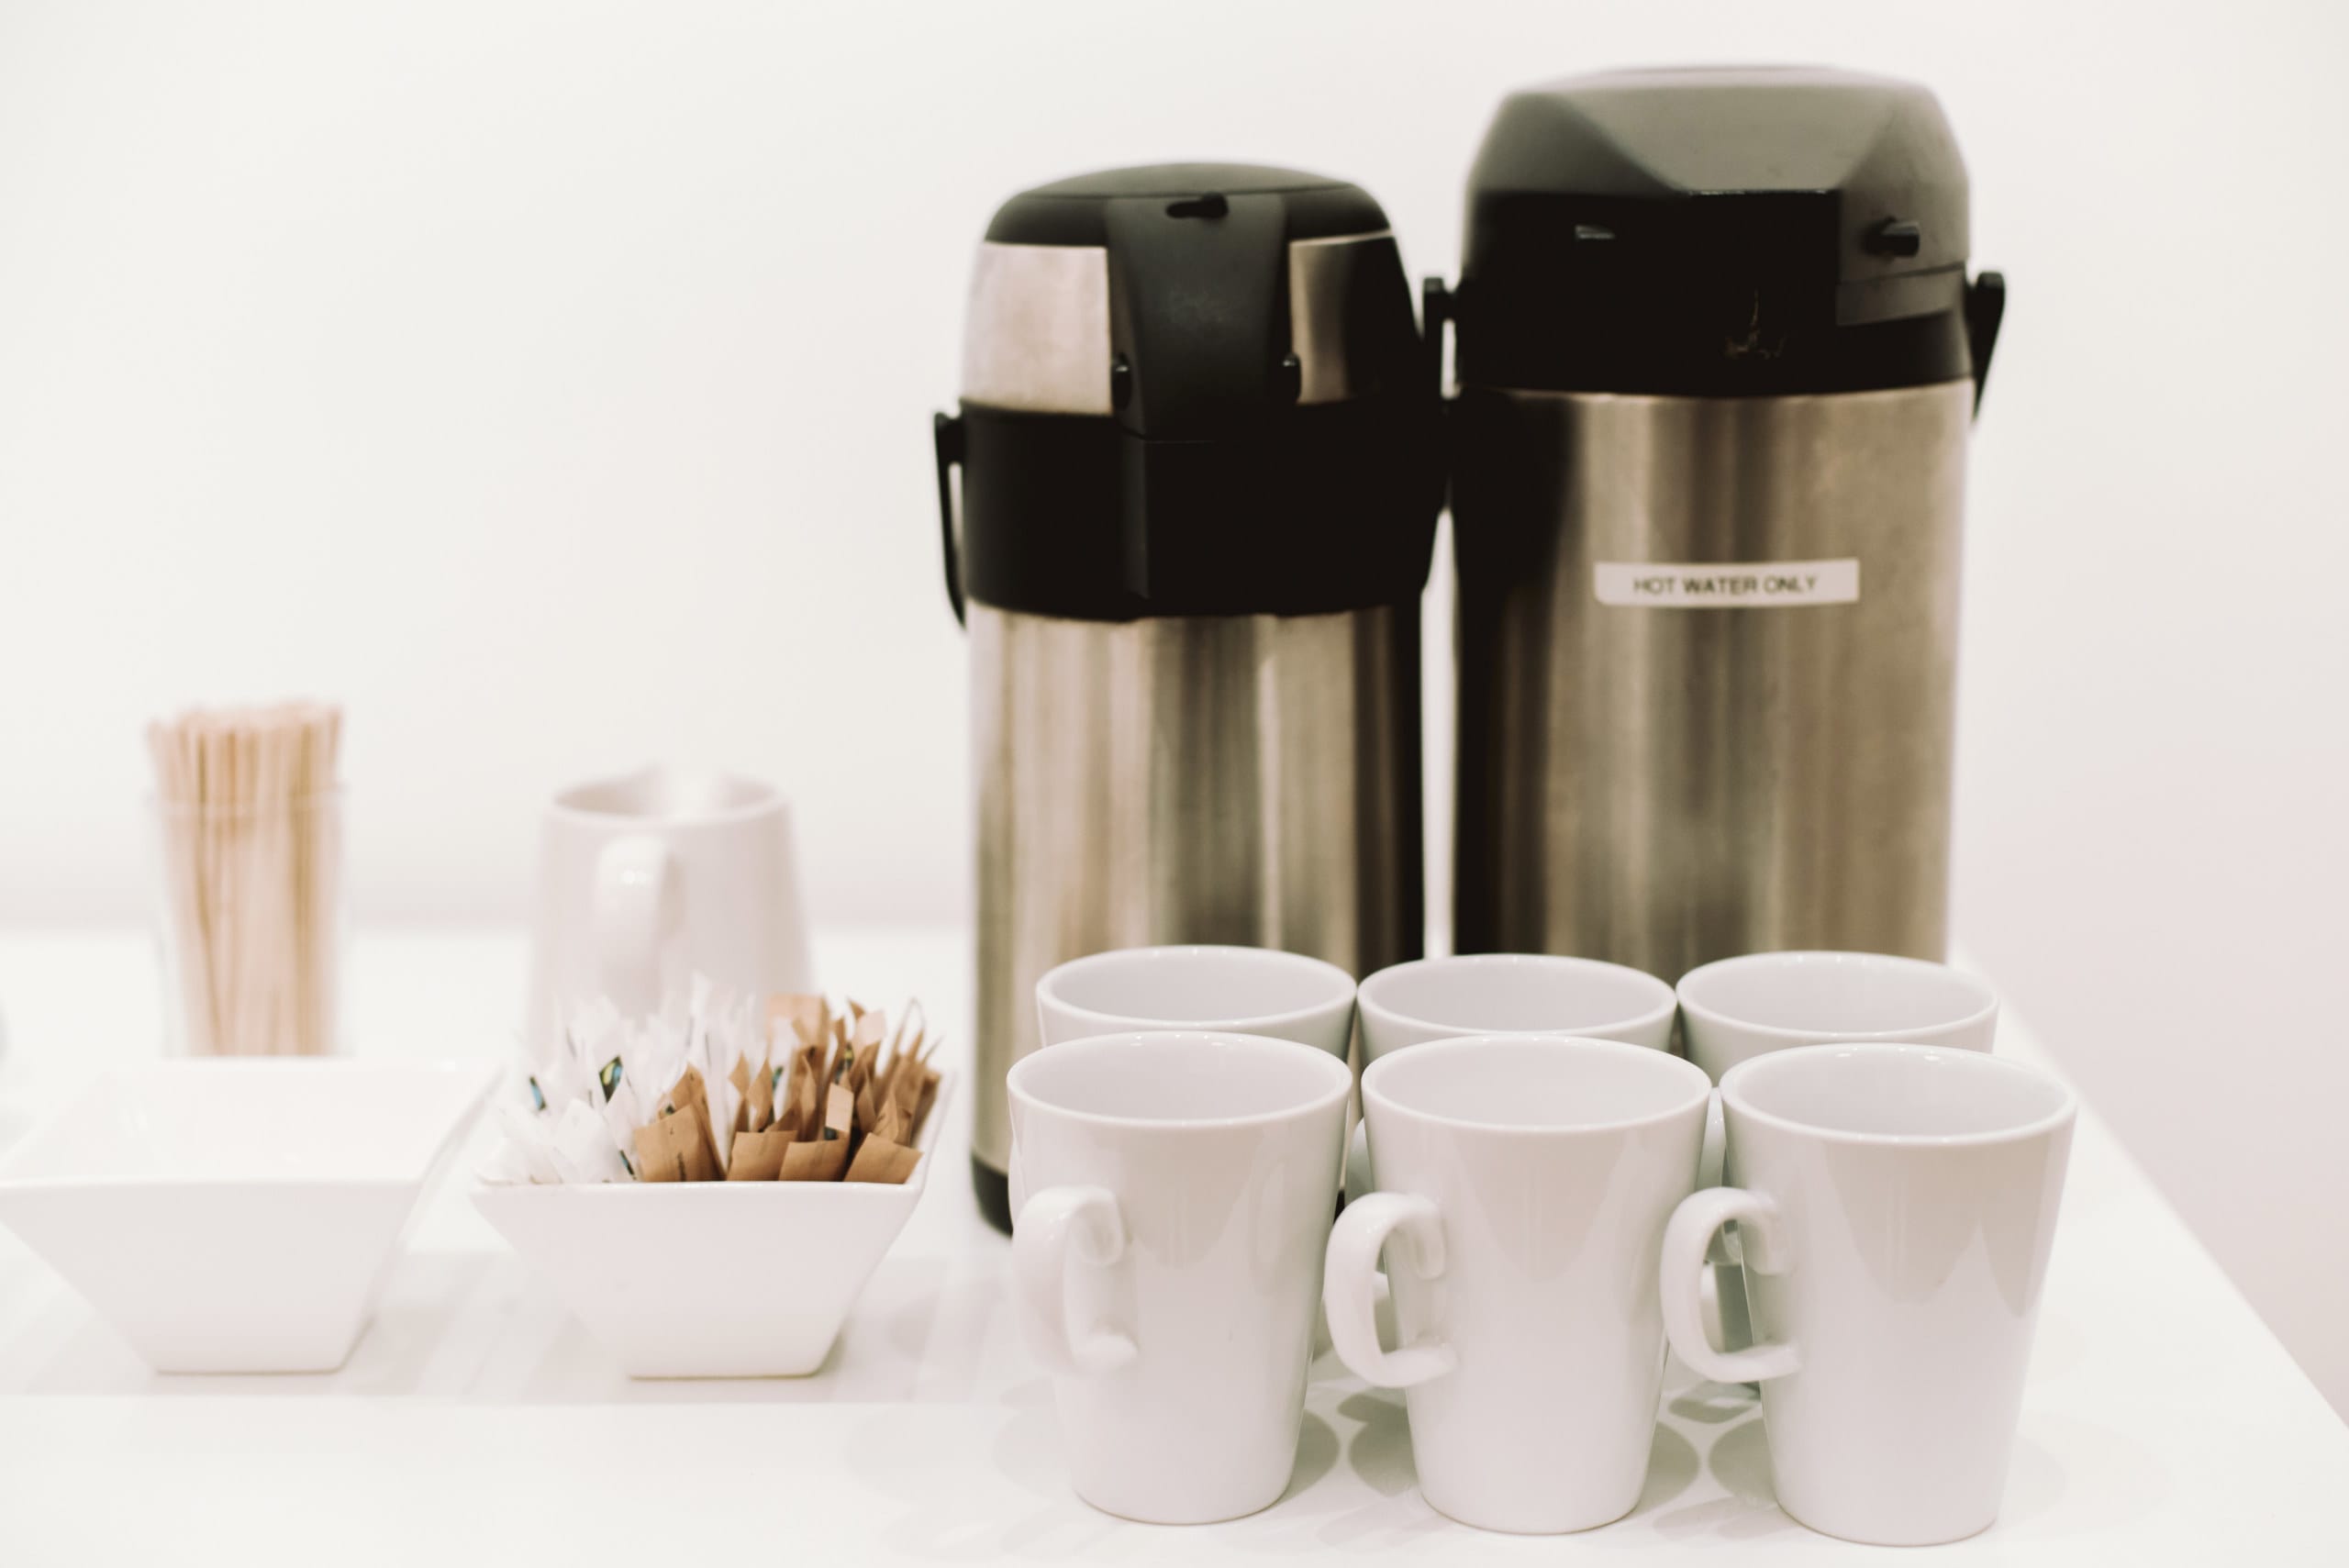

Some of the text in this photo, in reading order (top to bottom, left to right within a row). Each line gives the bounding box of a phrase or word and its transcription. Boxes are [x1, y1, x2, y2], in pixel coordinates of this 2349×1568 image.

[1633, 575, 1818, 595] HOT WATER ONLY
